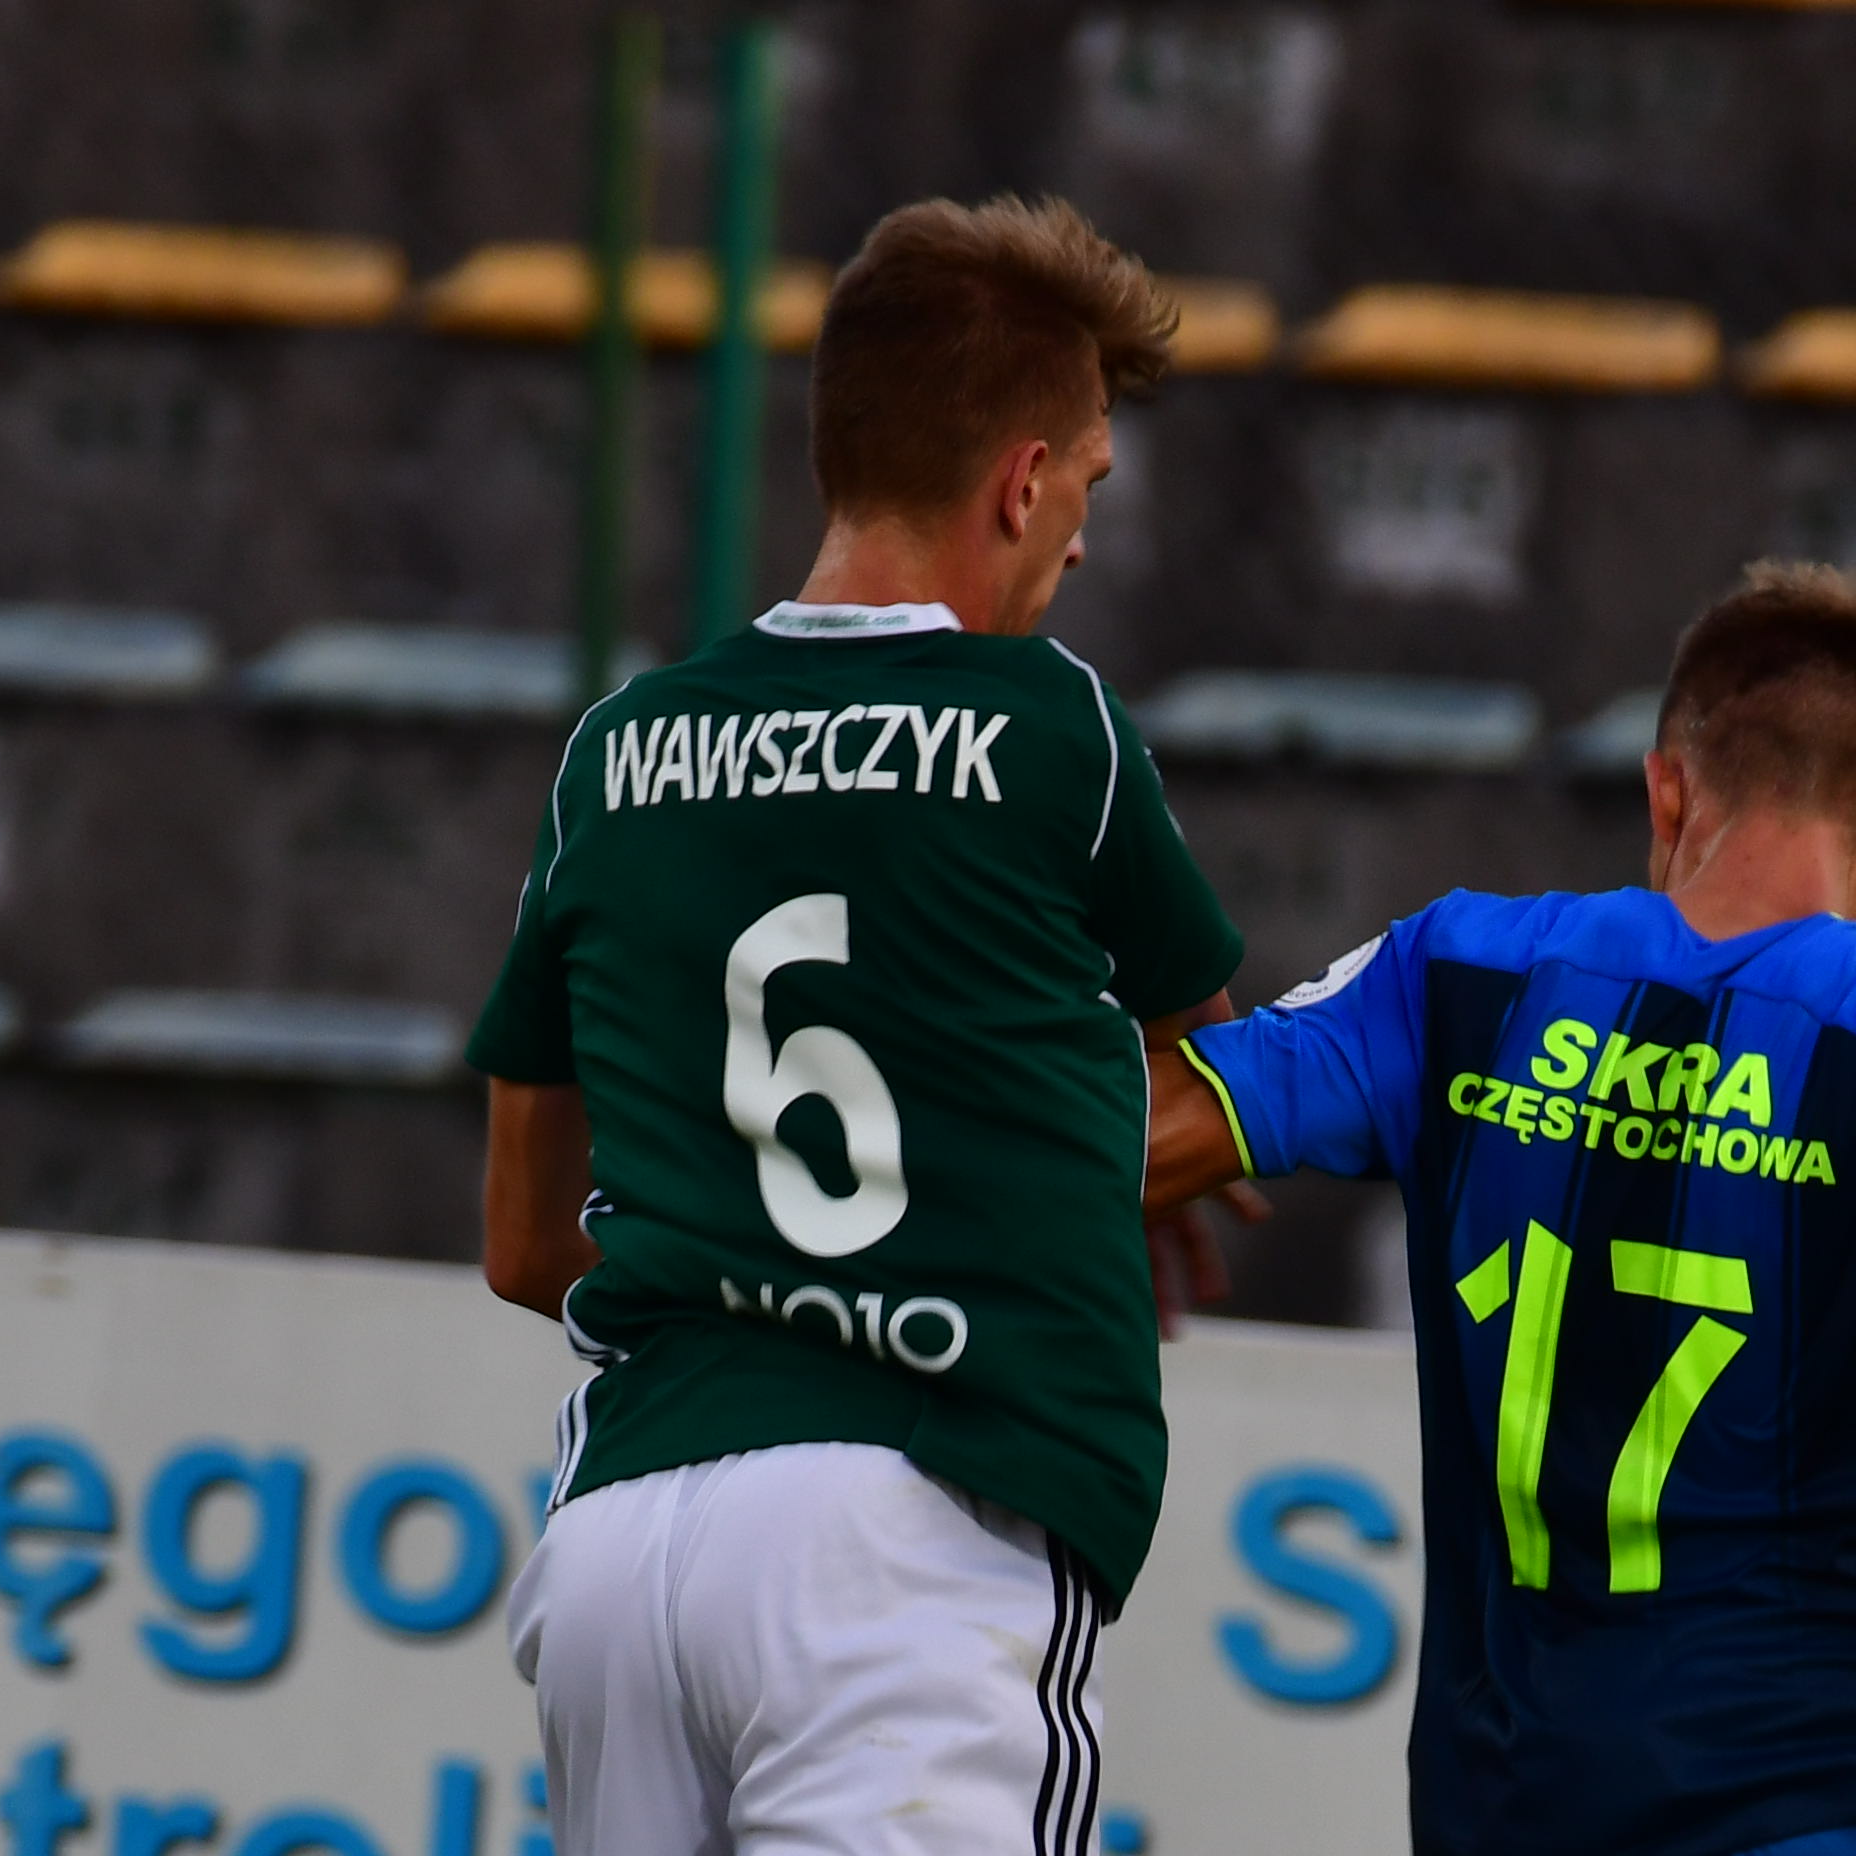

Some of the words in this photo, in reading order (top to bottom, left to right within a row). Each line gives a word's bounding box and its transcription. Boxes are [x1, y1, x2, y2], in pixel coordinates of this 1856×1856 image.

[603, 704, 1010, 812] WAWSZCZYK
[723, 893, 908, 1258] 6
[1447, 1071, 1838, 1187] CZĘSTOCHOWA
[1530, 1018, 1772, 1128] SKRA
[1456, 1218, 1753, 1594] 17
